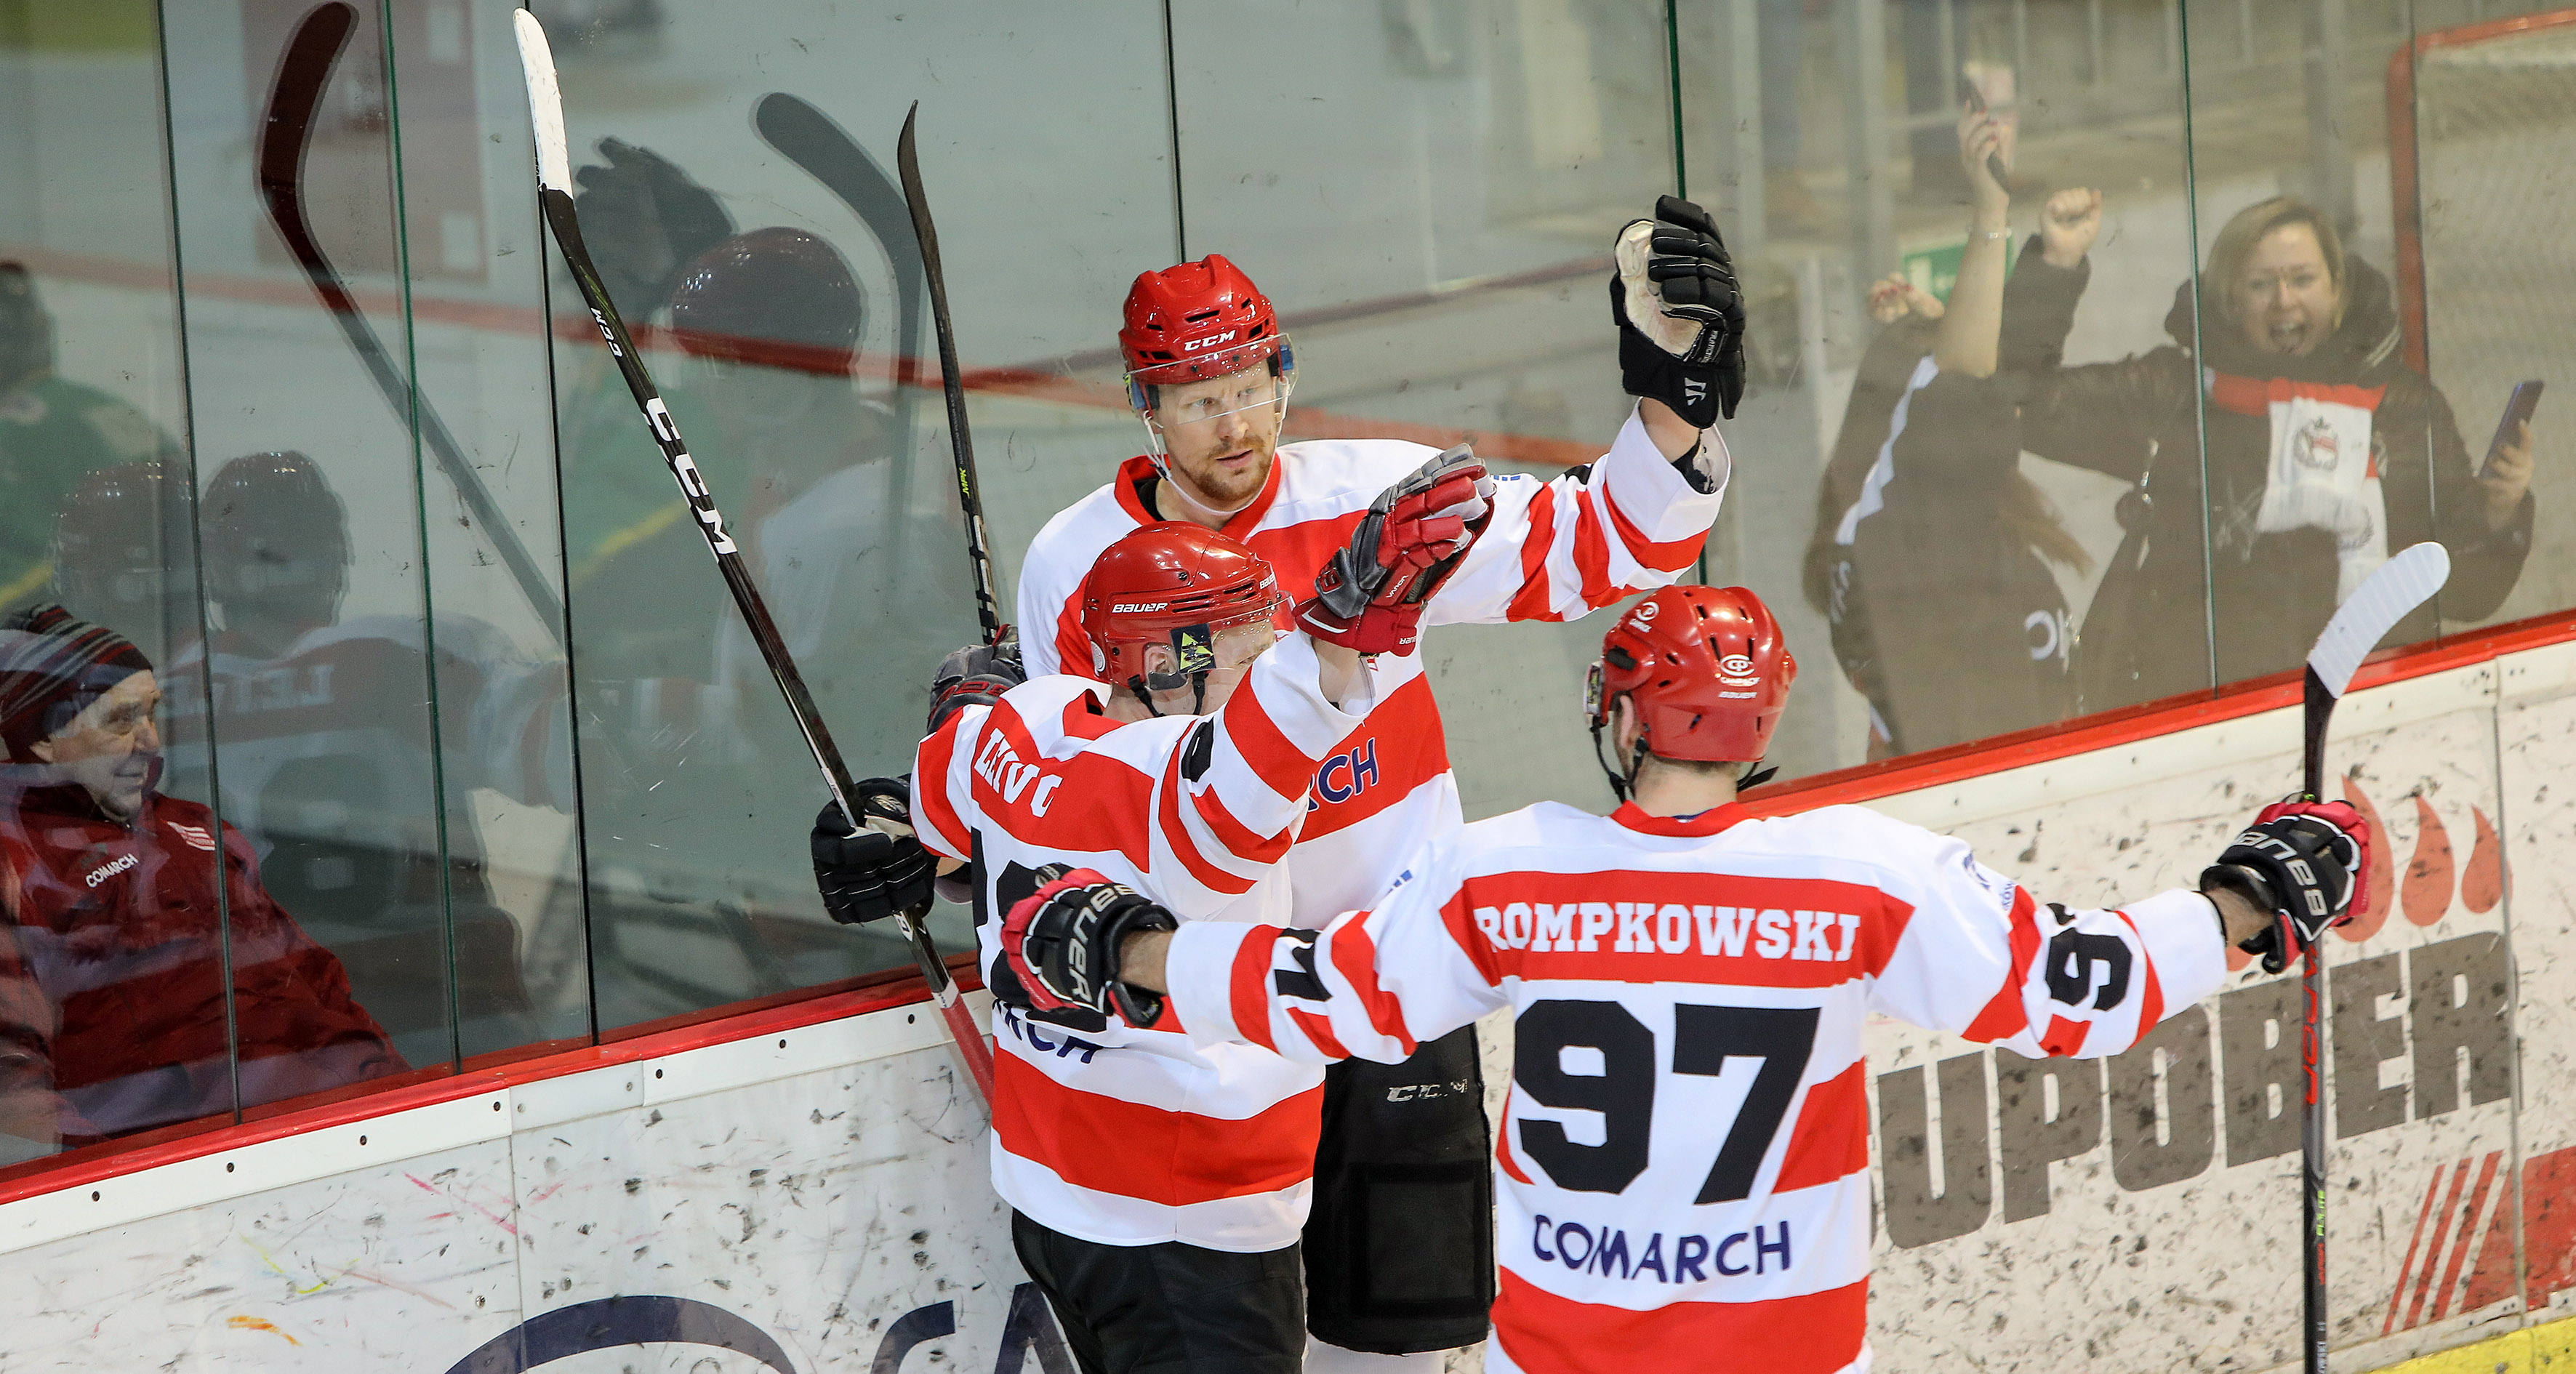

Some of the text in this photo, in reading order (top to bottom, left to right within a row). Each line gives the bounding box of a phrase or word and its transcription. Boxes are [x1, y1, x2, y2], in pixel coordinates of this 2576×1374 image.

[590, 308, 623, 357] CCM
[1184, 329, 1237, 352] CCM
[646, 395, 739, 555] CCM
[1112, 603, 1168, 614] BAUER
[1386, 575, 1409, 598] VAPOR
[1187, 659, 1211, 672] FISCHER
[85, 852, 138, 889] COMARCH
[1067, 883, 1139, 1003] BAUER
[1474, 902, 1861, 962] ROMPKOWSKI
[1514, 1000, 1823, 1206] 97
[1533, 1215, 1791, 1284] COMARCH
